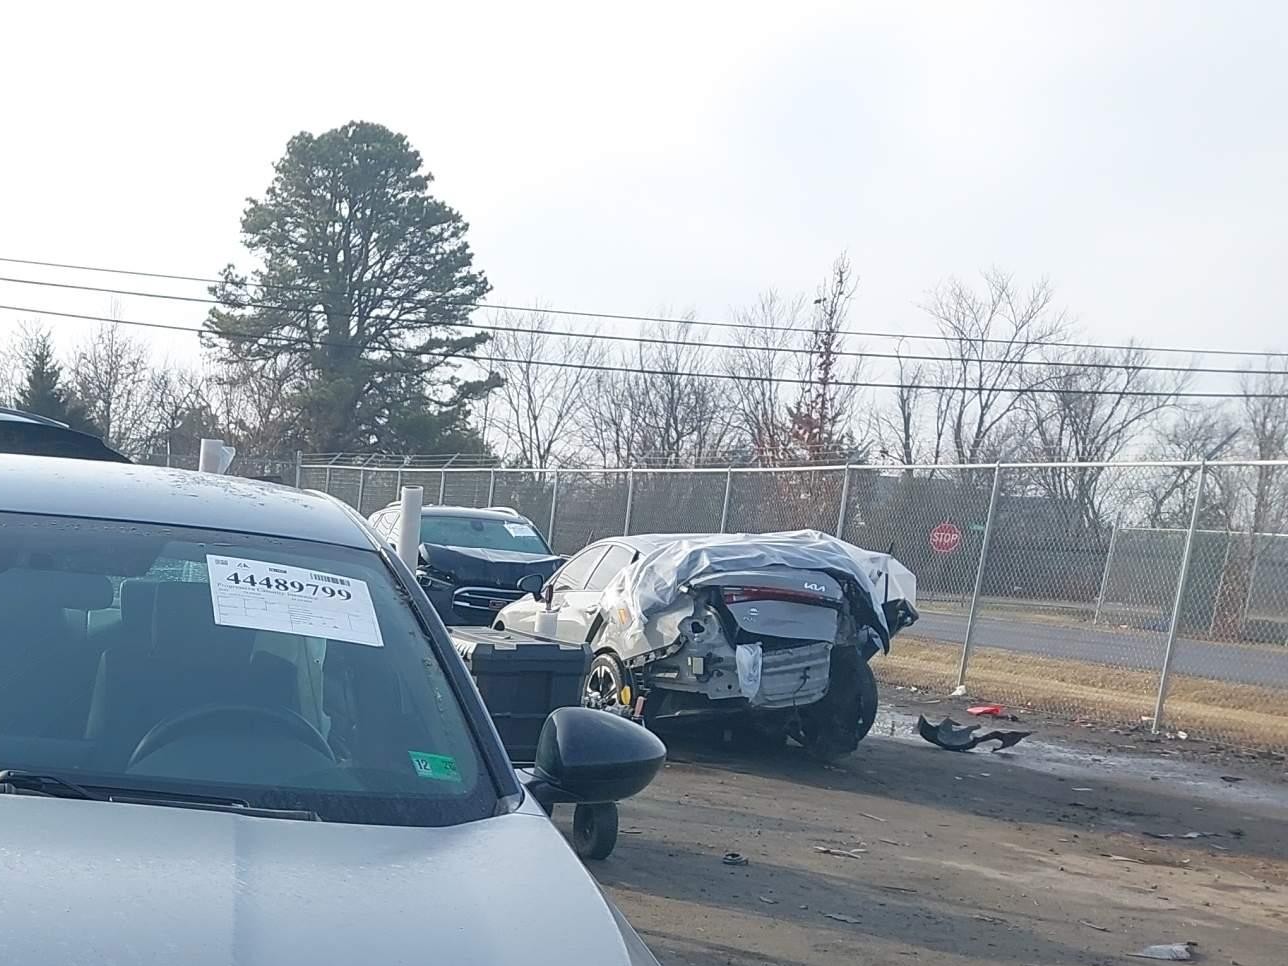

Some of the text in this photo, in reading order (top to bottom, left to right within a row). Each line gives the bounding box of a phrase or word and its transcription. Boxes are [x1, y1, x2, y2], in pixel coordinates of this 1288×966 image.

[932, 532, 958, 543] STOP
[226, 572, 353, 601] 44489799
[415, 759, 432, 770] 12
